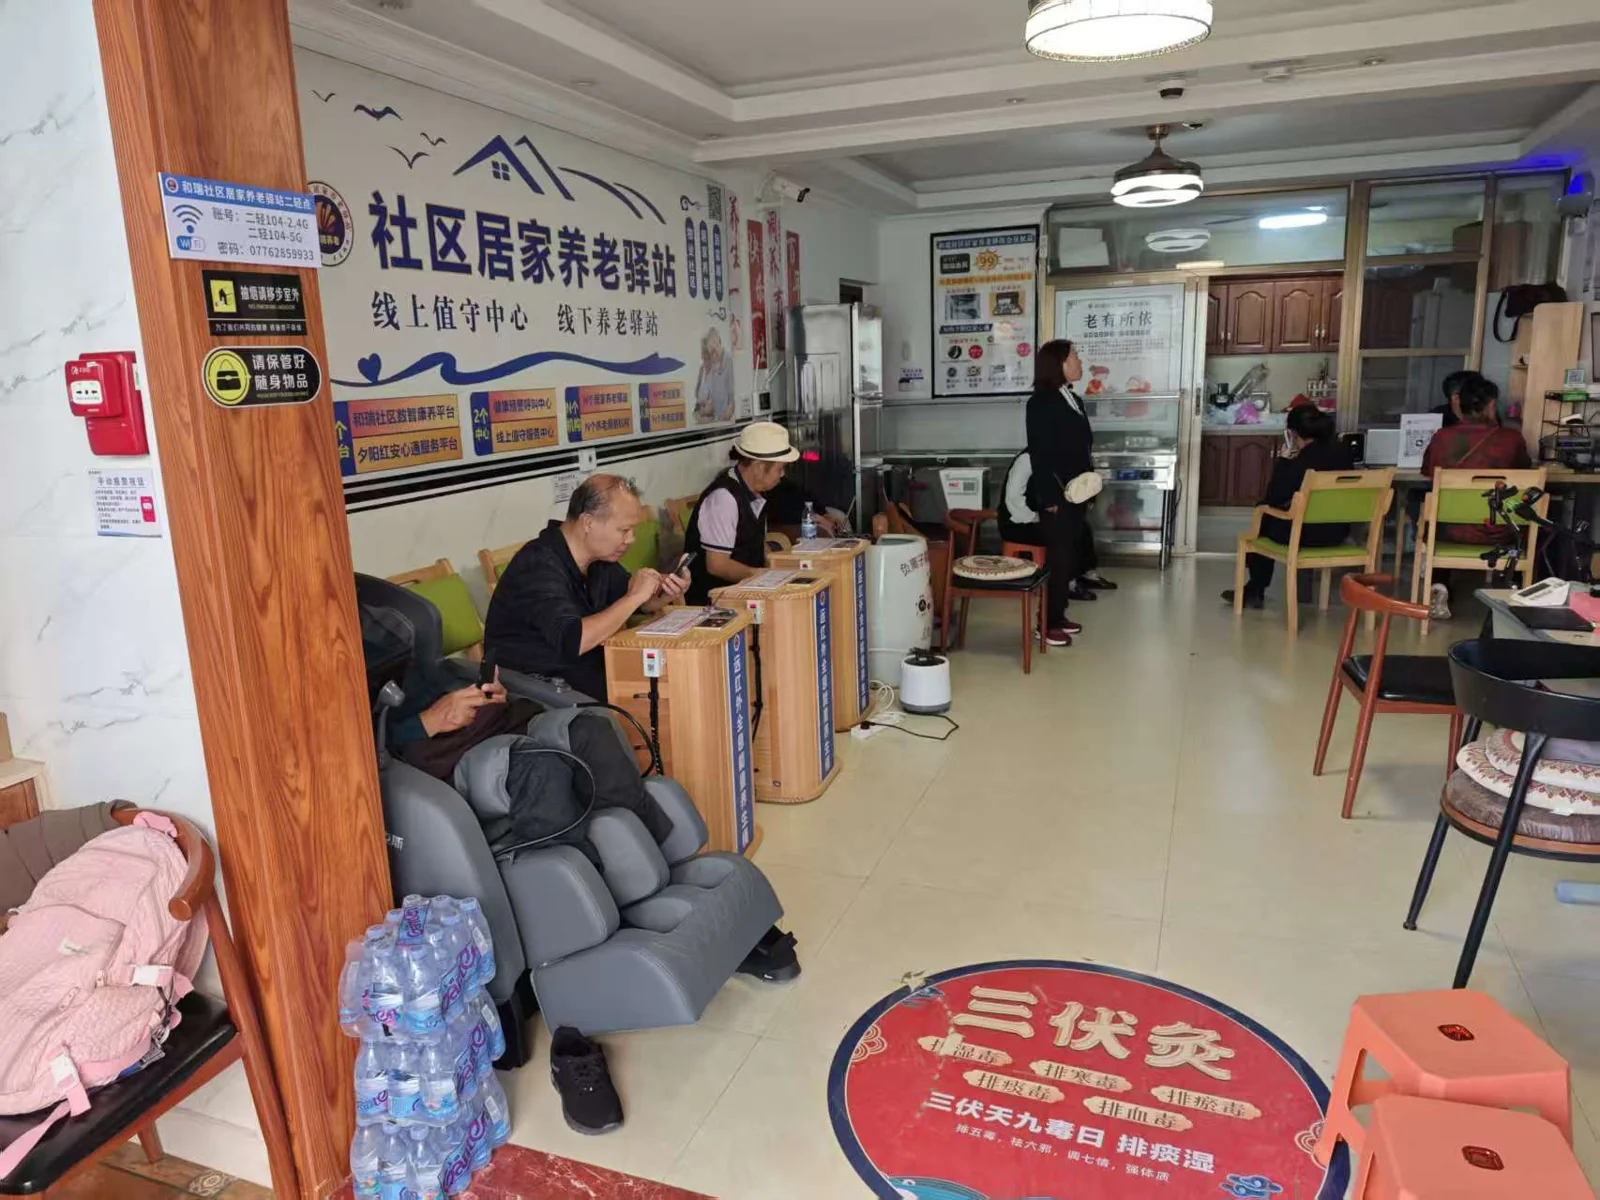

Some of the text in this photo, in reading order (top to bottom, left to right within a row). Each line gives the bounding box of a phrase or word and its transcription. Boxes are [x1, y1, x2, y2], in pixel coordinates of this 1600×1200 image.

[368, 190, 677, 298] 社区居家养老驿站
[371, 290, 659, 337] 线上值守中心 线下养老驿站
[1084, 310, 1152, 329] 老有所依
[252, 354, 306, 370] 请保管好
[254, 373, 308, 390] 随身物品
[952, 984, 1236, 1081] 三伏灸
[977, 1072, 1052, 1101] 排痰毒
[1044, 1063, 1118, 1092] 排寒毒
[1100, 1099, 1177, 1130] 排血毒
[1166, 1088, 1248, 1119] 排瘀毒
[923, 1090, 1215, 1175] 三伏天九毒日 排痰湿
